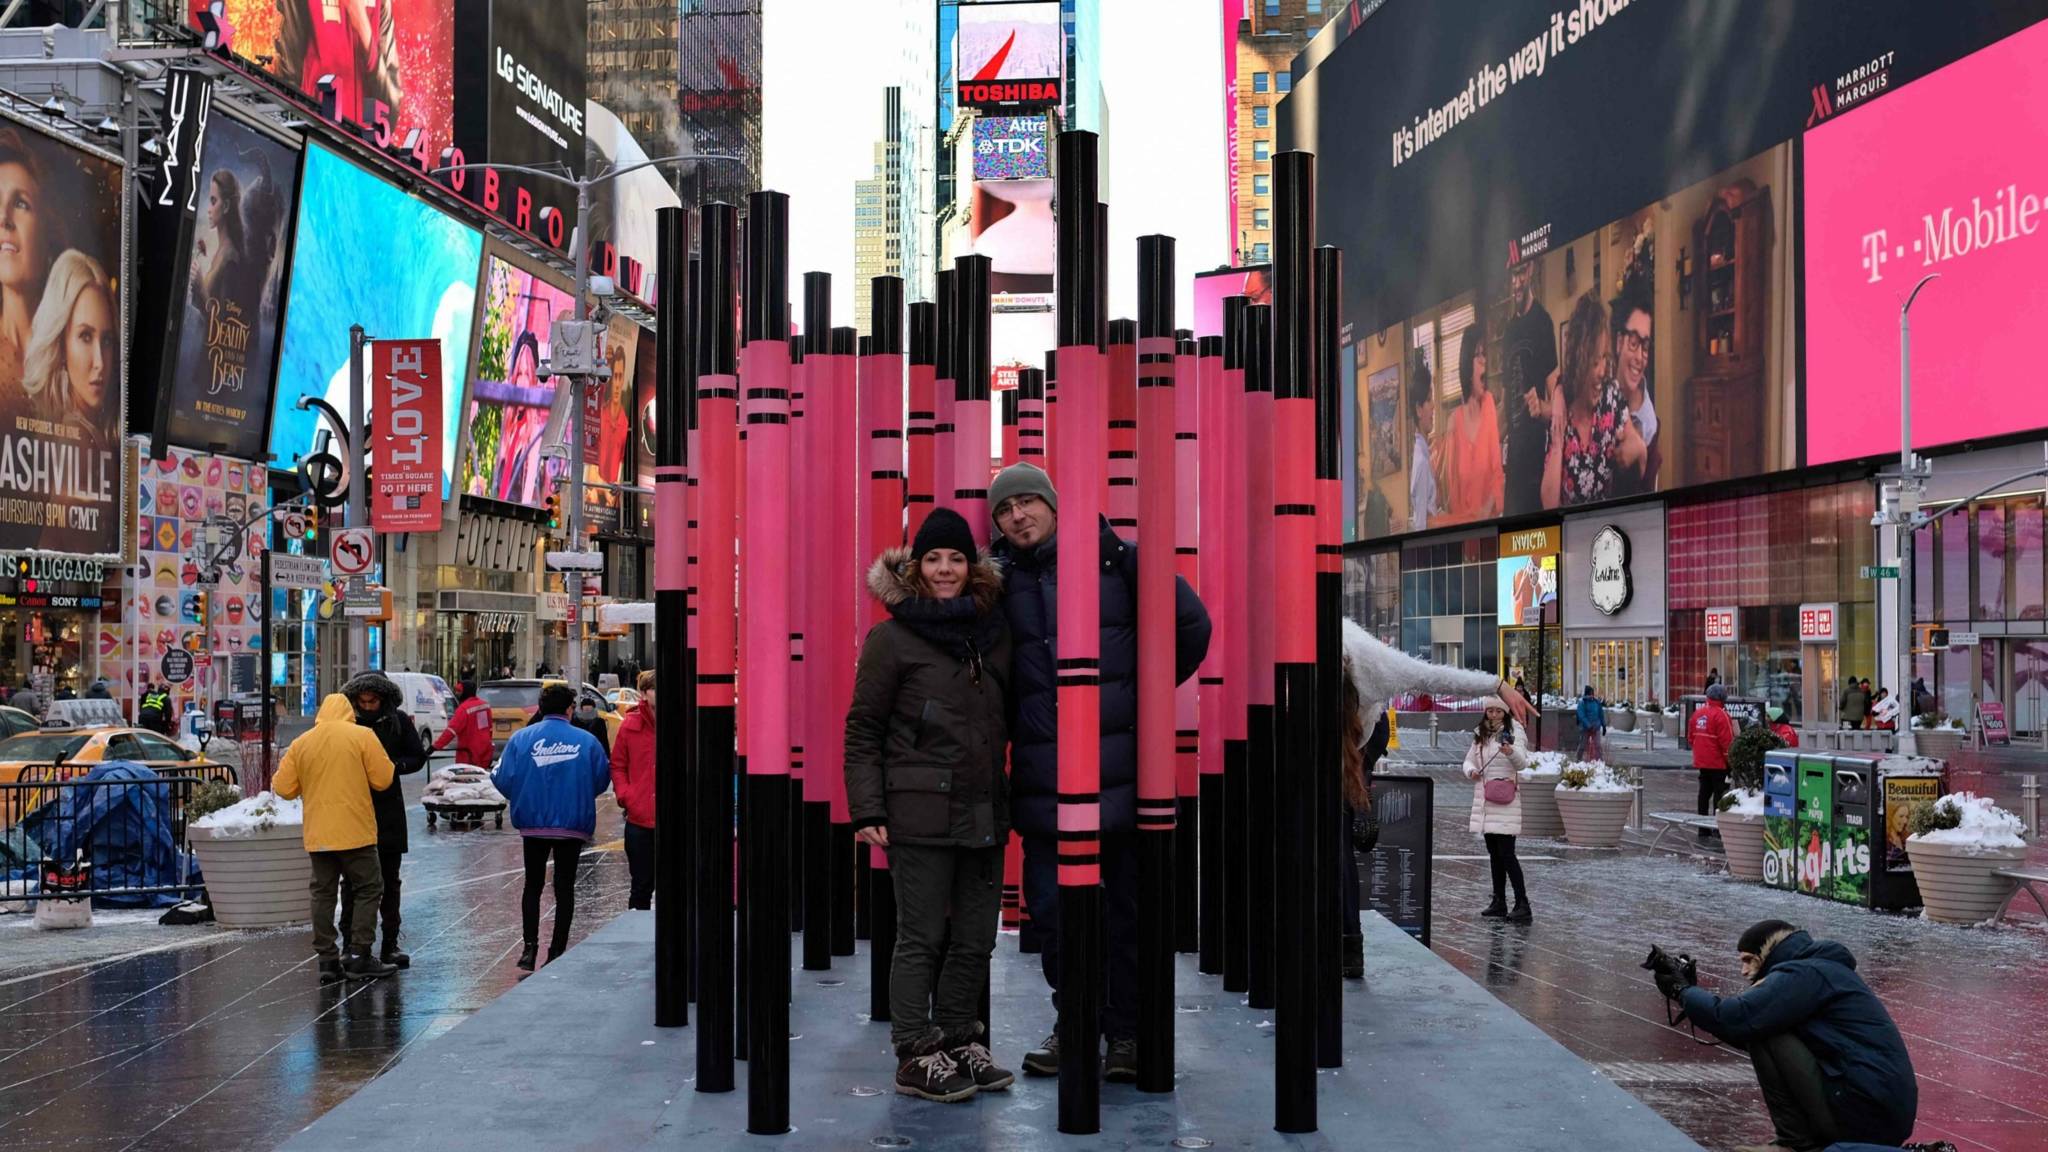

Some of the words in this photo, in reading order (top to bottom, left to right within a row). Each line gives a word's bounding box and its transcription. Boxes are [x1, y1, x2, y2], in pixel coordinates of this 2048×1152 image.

[1836, 51, 1894, 90] MARRIOTT
[497, 46, 514, 83] LG
[517, 64, 583, 136] SIGNATURE
[959, 83, 1059, 102] TOSHIBA
[1393, 125, 1414, 168] It's
[1415, 78, 1476, 152] internet
[1477, 64, 1507, 107] the
[1509, 30, 1548, 85] way
[1551, 11, 1565, 58] it
[1567, 0, 1630, 44] shou
[1836, 74, 1888, 108] MARQUIS
[1009, 119, 1047, 132] Attra
[992, 138, 1045, 153] TDK
[1521, 223, 1551, 245] MARRIOTT
[1521, 238, 1548, 258] MARQUIS
[391, 346, 423, 465] LOVE
[405, 472, 434, 480] SQUARE
[381, 484, 394, 493] DO
[396, 484, 405, 493] IT
[407, 483, 433, 493] HERE
[46, 503, 66, 528] 9PM
[68, 505, 99, 531] CMT
[455, 511, 540, 572] FOREVER
[1512, 531, 1548, 552] INVICTA
[31, 556, 104, 582] LUGGAGE
[1870, 568, 1878, 577] W
[1881, 568, 1891, 577] 46
[52, 596, 78, 606] SONY
[476, 612, 510, 632] FOREVER
[1819, 612, 1830, 622] UNI
[1721, 626, 1731, 635] QLO
[1819, 623, 1830, 634] QLO
[531, 738, 580, 756] Indians
[1888, 782, 1936, 795] Beautiful
[1846, 814, 1863, 825] TRASH
